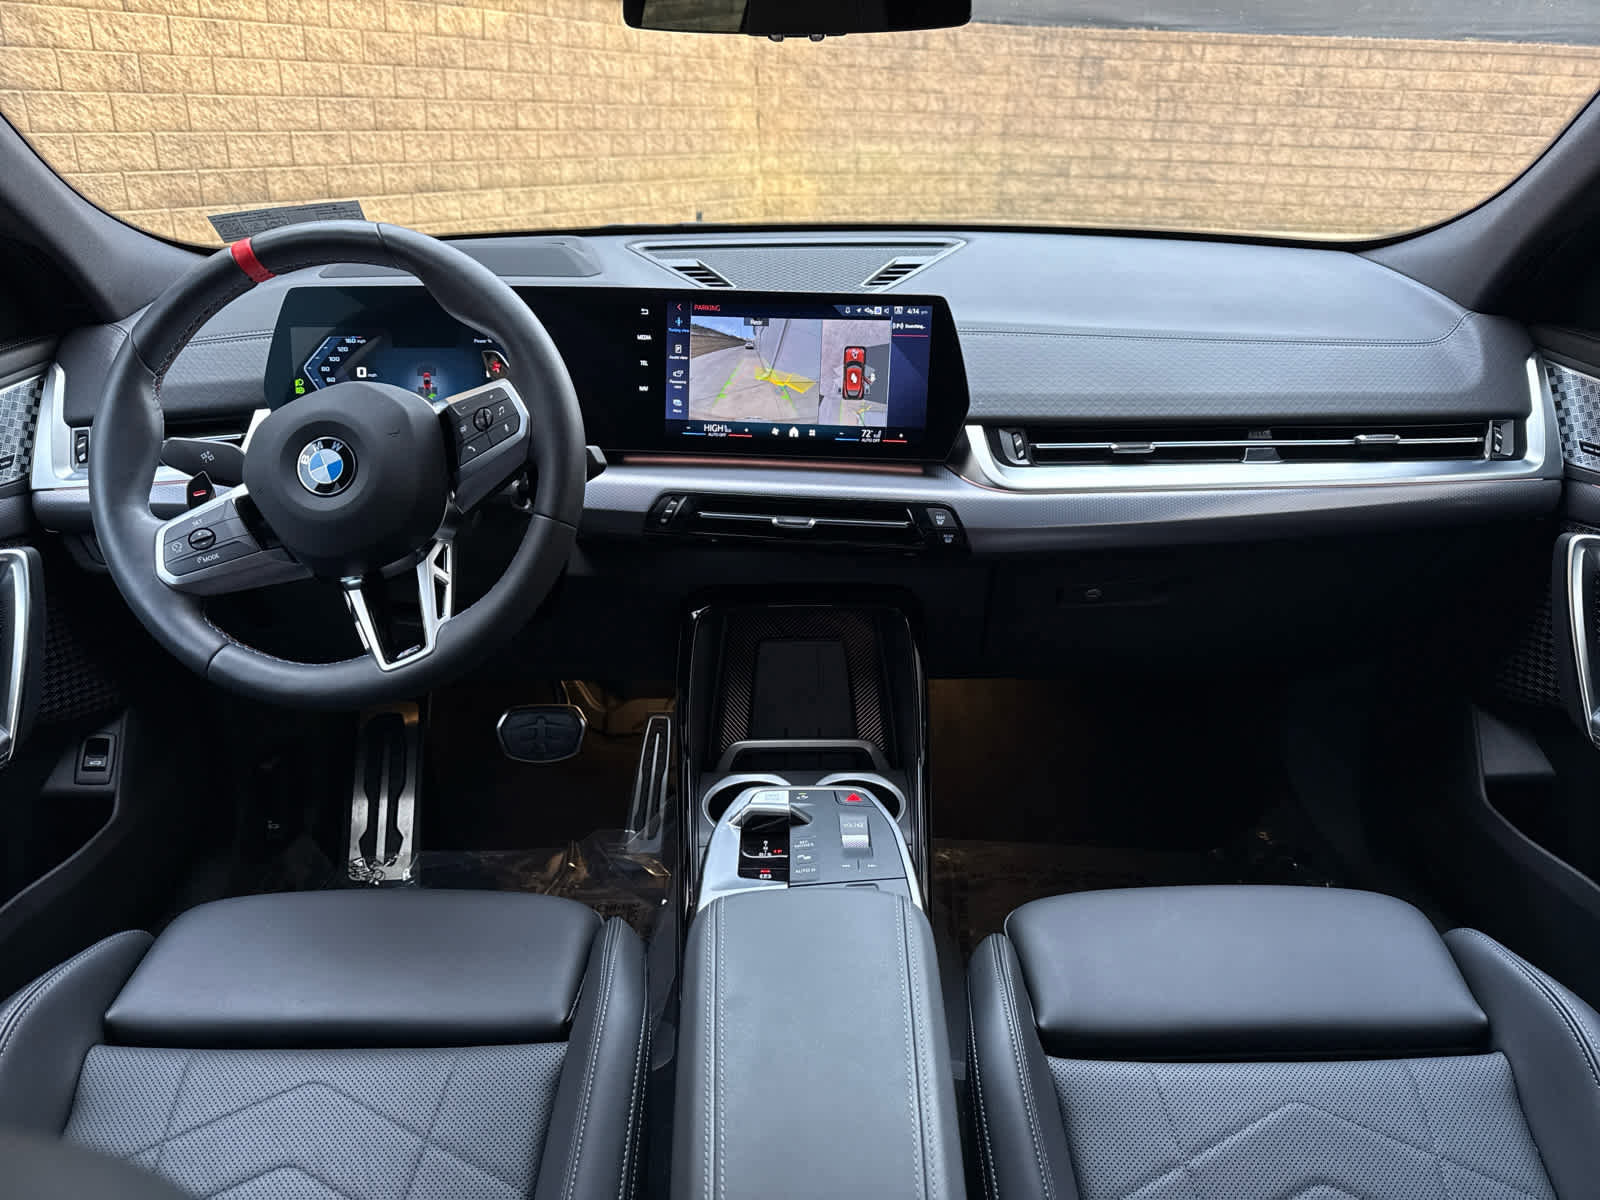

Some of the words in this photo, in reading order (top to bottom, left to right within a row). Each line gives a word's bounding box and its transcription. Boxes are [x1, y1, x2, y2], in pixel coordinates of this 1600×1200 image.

[356, 367, 367, 378] 0
[704, 424, 724, 432] HIGH
[300, 440, 343, 465] BMW
[203, 553, 219, 562] MODE
